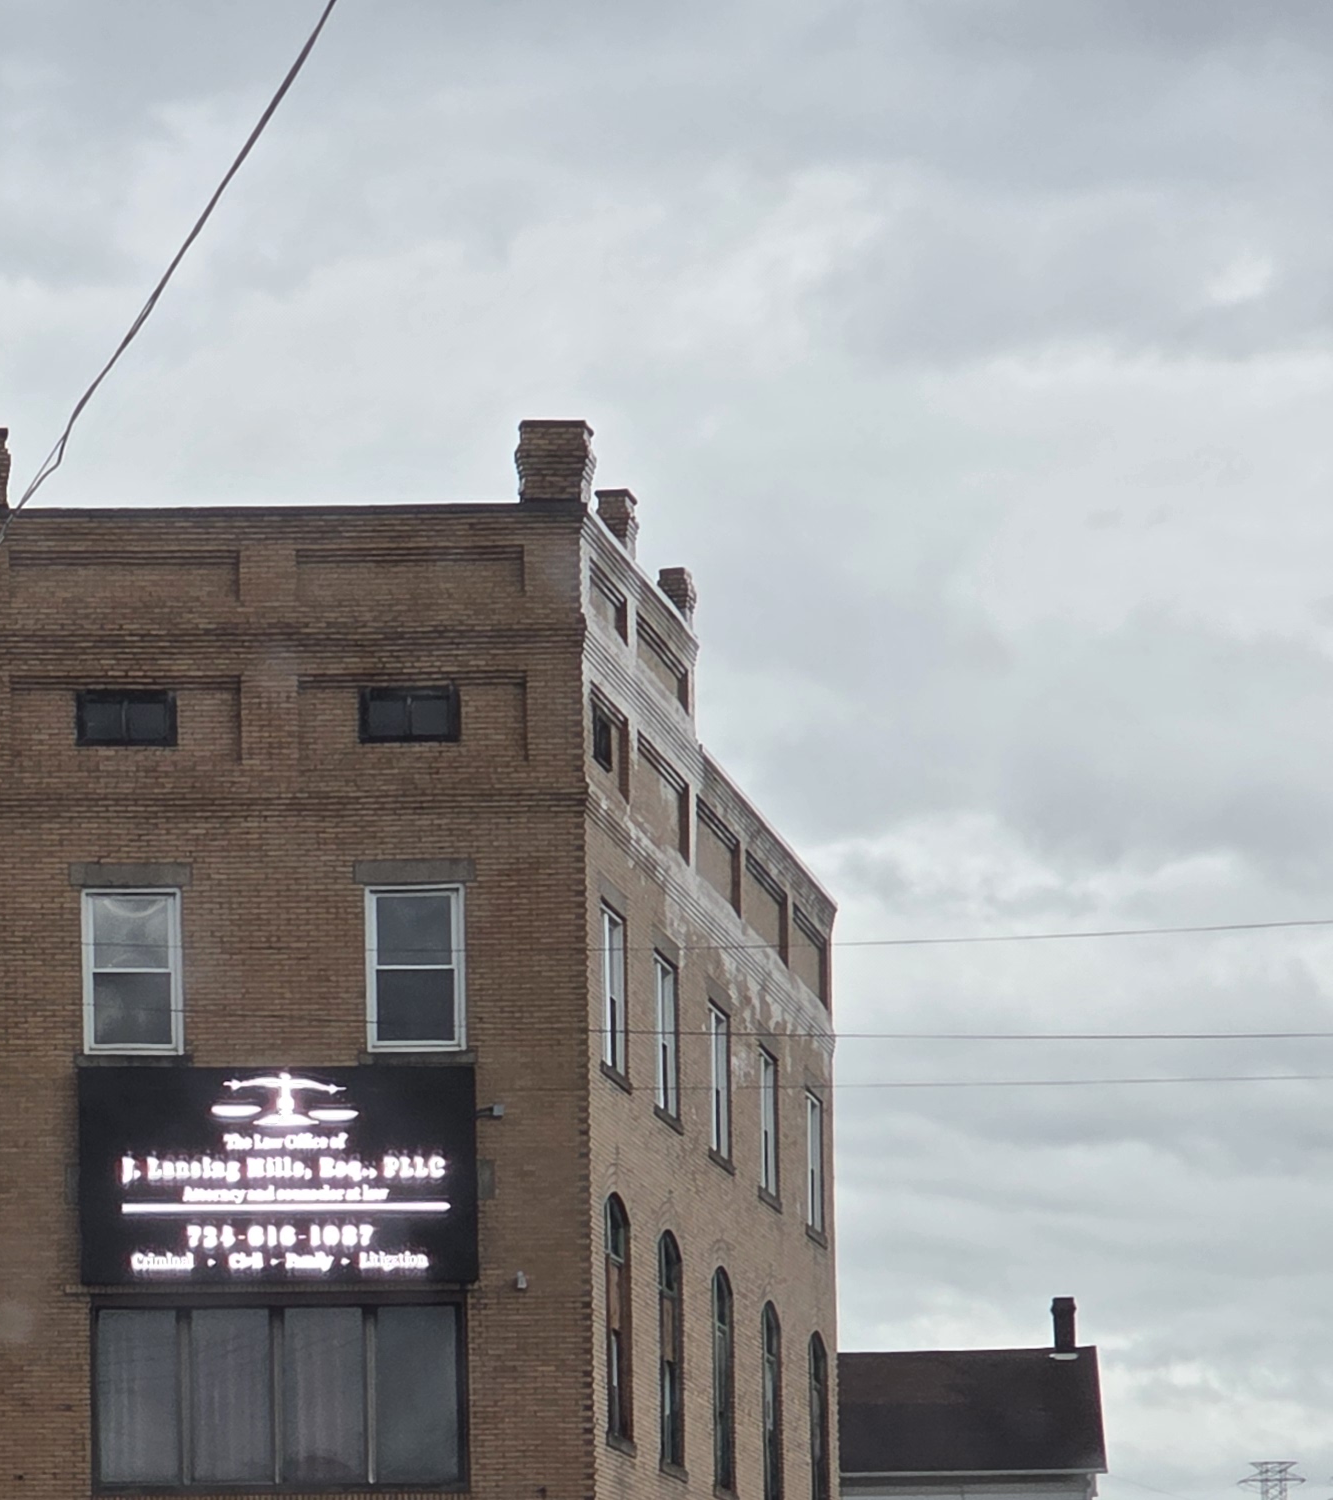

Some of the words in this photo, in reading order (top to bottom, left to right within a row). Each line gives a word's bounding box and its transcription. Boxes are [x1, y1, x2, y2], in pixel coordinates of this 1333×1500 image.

[383, 1155, 446, 1179] PLLC
[130, 1252, 194, 1271] Criminal
[359, 1251, 429, 1271] Litigation
